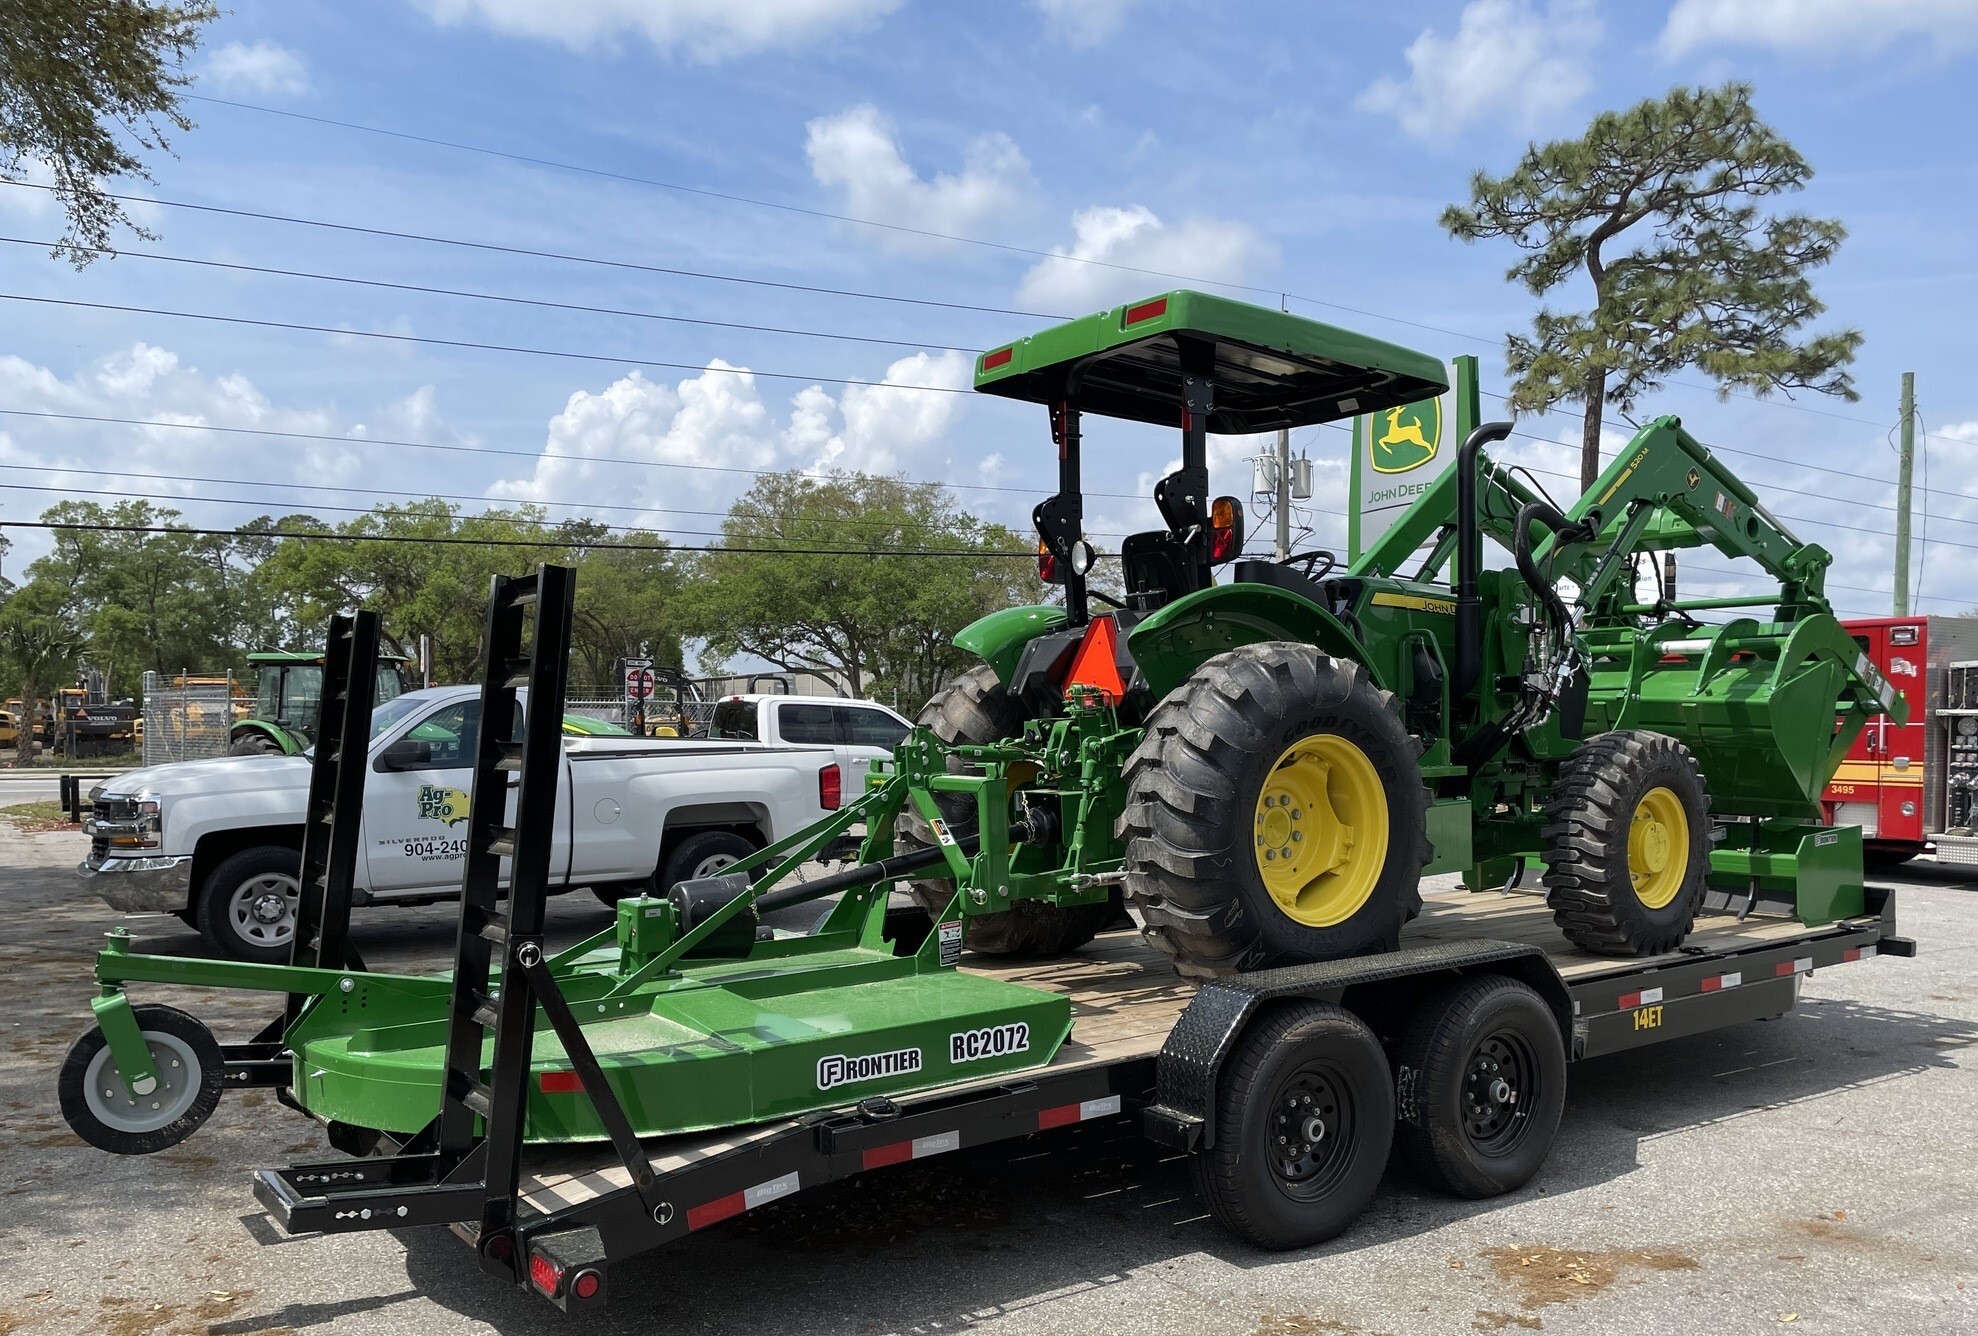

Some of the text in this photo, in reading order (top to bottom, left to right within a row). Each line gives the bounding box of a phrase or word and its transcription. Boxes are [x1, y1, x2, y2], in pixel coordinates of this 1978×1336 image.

[1629, 453, 1644, 470] 520
[1368, 488, 1397, 504] JOHN
[1421, 600, 1449, 614] JOHN
[419, 786, 452, 804] Ag-
[1831, 785, 1855, 794] 3495
[420, 802, 453, 818] Pro
[379, 835, 446, 845] SILVERADO
[1633, 1005, 1663, 1031] 14ET
[952, 1025, 1027, 1060] RC2072
[819, 1049, 920, 1087] FRONTIER
